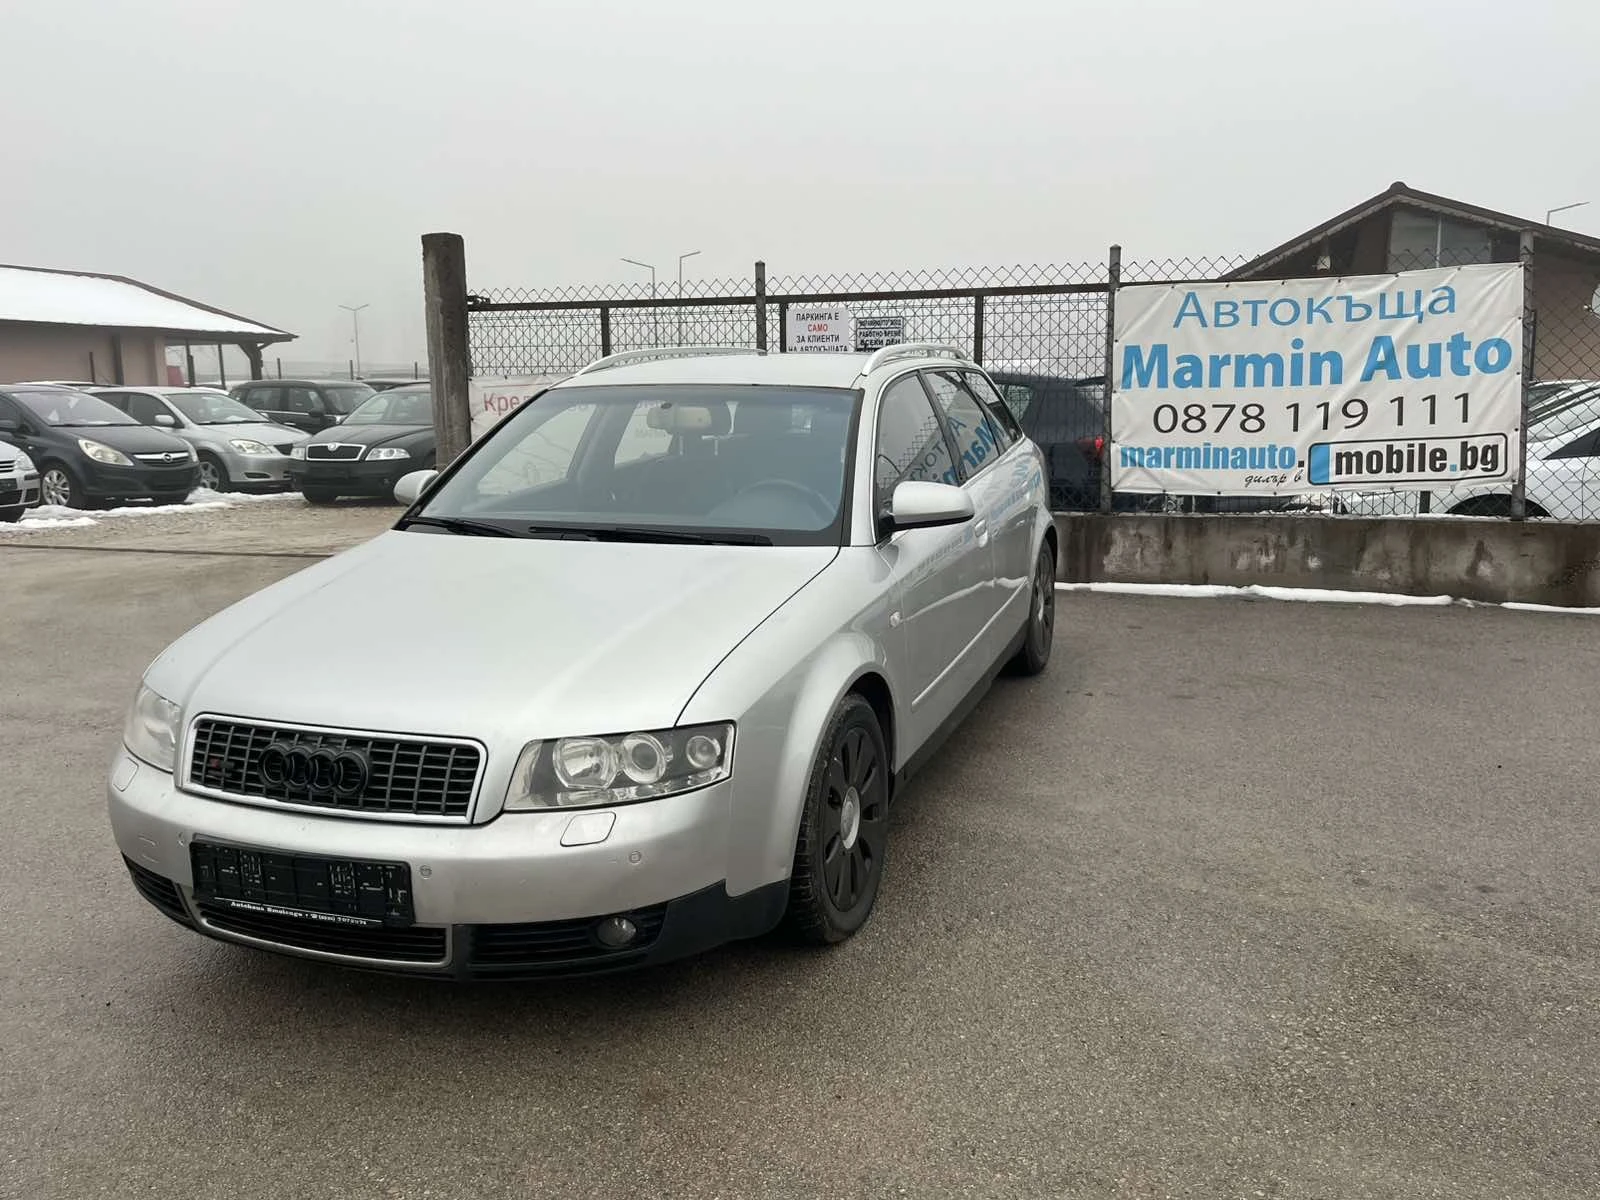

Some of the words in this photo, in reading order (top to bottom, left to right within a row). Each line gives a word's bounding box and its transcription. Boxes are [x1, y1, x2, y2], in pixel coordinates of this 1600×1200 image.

[796, 312, 832, 321] ПАРКИНГА
[835, 312, 840, 320] Е
[1173, 284, 1457, 329] Автокъща
[796, 335, 805, 343] ЗА
[808, 334, 840, 343] КЛИЕНТИ
[807, 323, 828, 332] САМО
[1121, 338, 1344, 391] Marmin
[1360, 331, 1513, 383] Auto
[1153, 403, 1266, 434] 0878
[1286, 398, 1370, 433] 119
[1390, 393, 1470, 426] 111
[1335, 441, 1499, 476] mobile.bg
